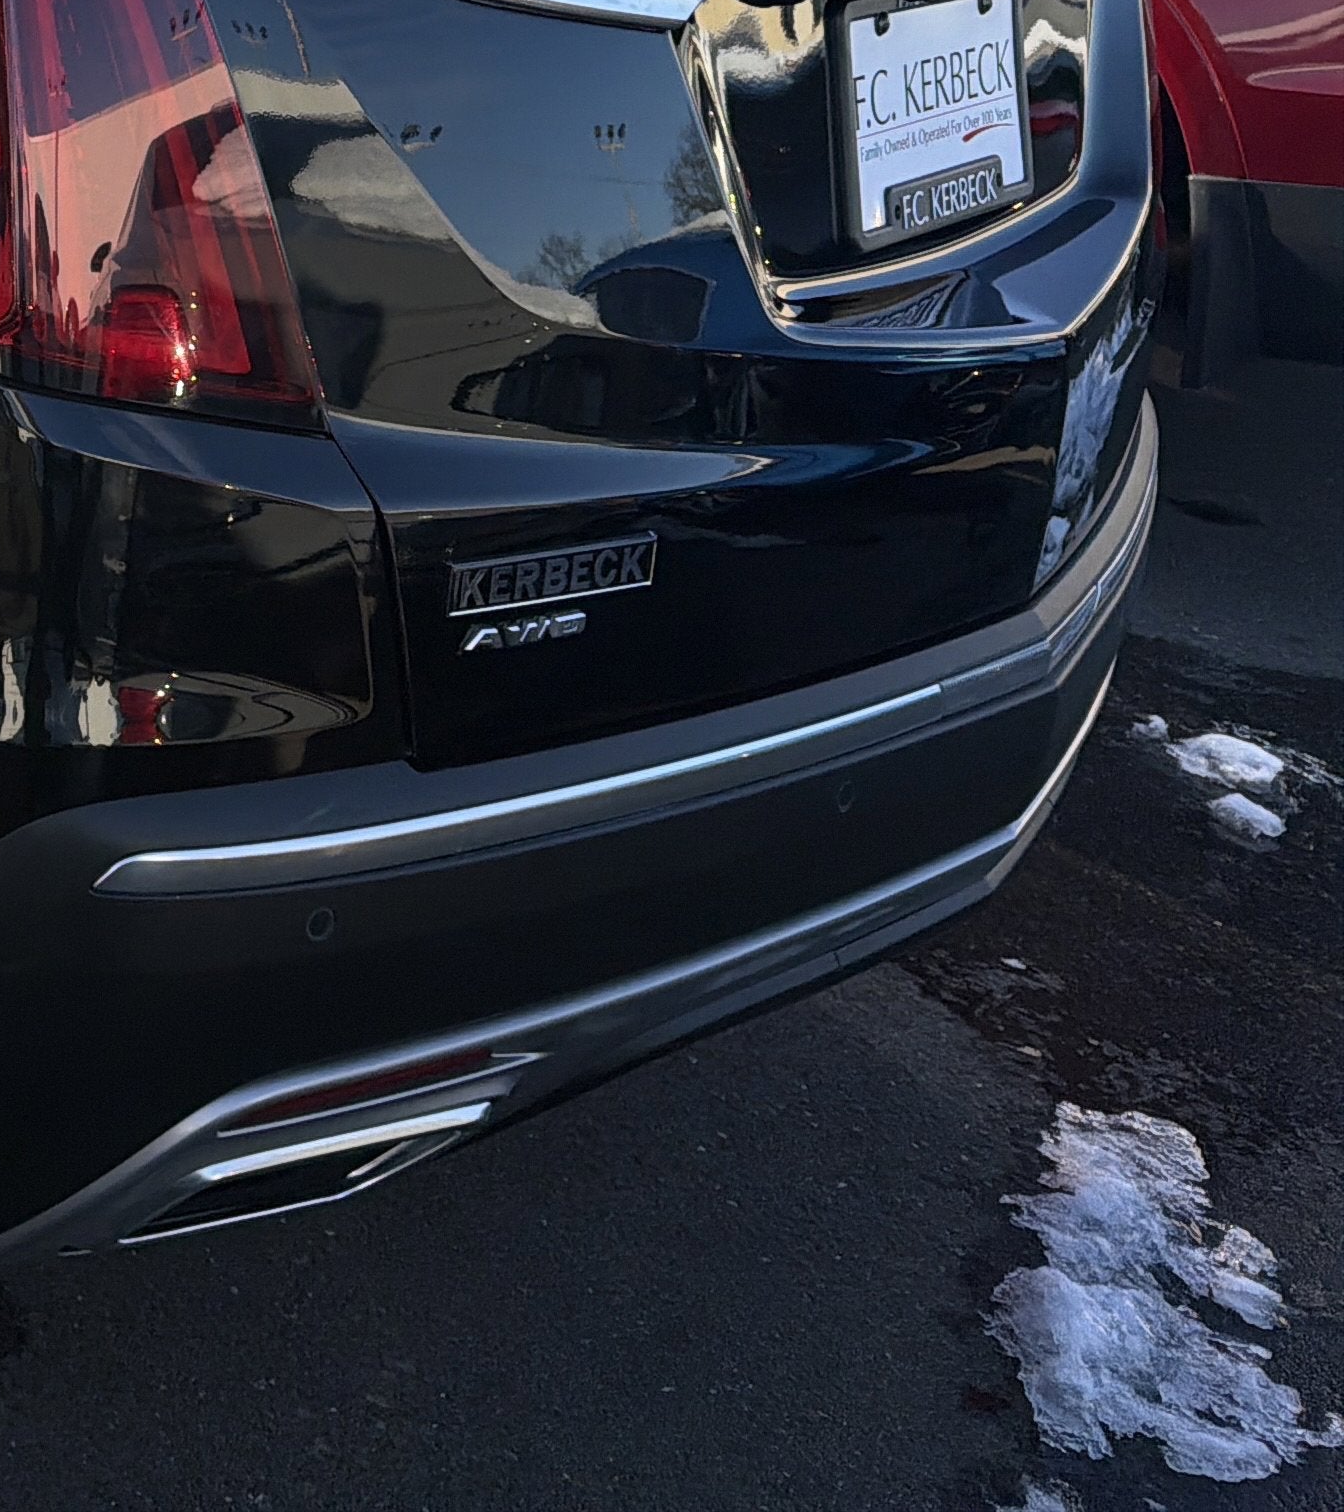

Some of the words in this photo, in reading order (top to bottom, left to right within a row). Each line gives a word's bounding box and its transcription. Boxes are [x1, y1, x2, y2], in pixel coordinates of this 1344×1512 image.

[903, 38, 1013, 117] KERBECK
[861, 141, 883, 163] Family
[884, 132, 911, 155] Owned
[918, 122, 950, 147] Operated
[951, 119, 963, 135] For
[963, 114, 981, 131] Over
[981, 108, 995, 126] 100
[995, 105, 1012, 122] Years
[902, 194, 929, 229] F.C.
[931, 168, 999, 219] KERBECK
[457, 545, 649, 609] KERBECK
